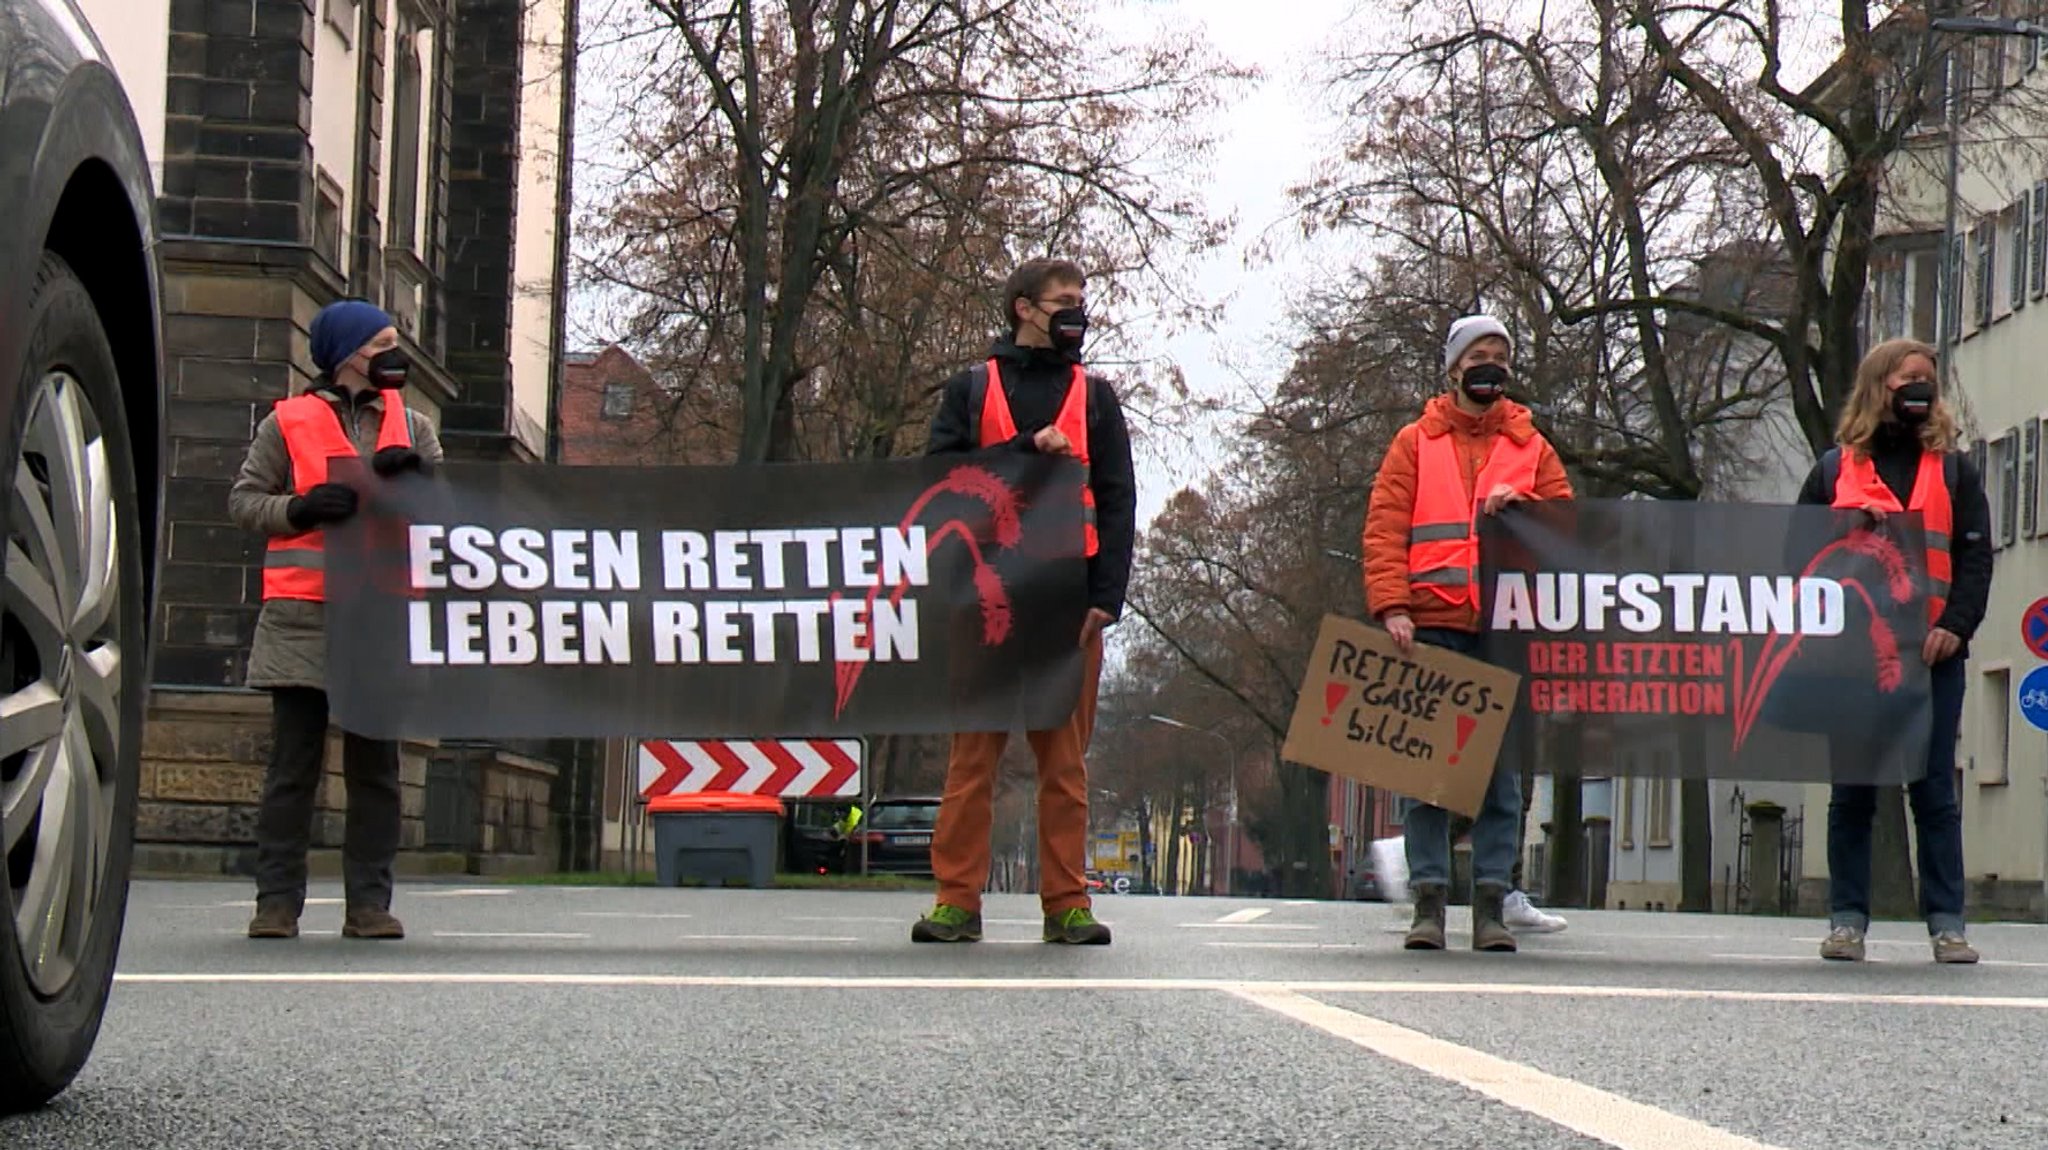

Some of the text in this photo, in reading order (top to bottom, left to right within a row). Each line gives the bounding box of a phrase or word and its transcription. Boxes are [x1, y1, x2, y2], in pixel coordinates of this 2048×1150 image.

[409, 524, 929, 590] ESSEN RETTEN
[408, 598, 919, 665] LEBEN RETTEN
[1490, 572, 1846, 636] AUFSTAND
[1329, 638, 1505, 715] RETTUNGS-
[1527, 640, 1724, 677] DER LETZTEN
[1362, 681, 1441, 721] GASSE
[1530, 679, 1725, 716] GENERATION
[1346, 706, 1434, 761] bilden
